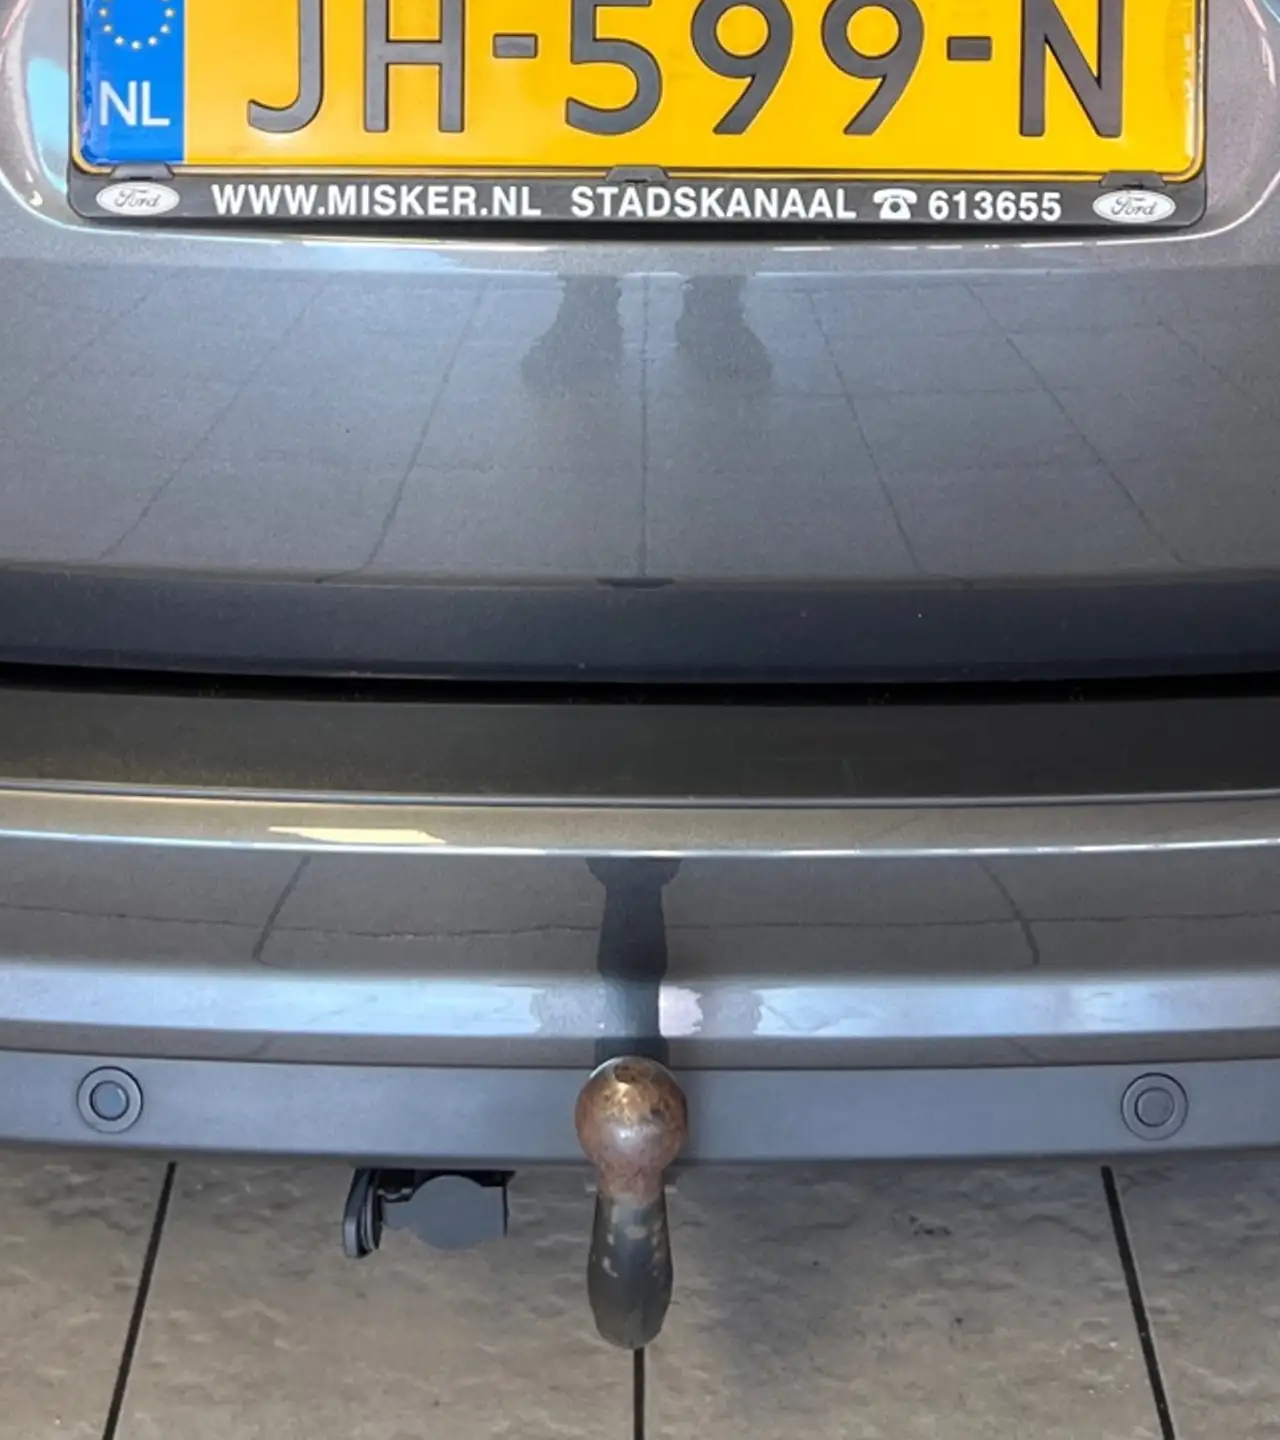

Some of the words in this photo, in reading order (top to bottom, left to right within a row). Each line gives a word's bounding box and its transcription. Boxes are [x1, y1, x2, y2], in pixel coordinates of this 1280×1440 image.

[100, 81, 169, 126] NL
[114, 188, 162, 208] Ford
[211, 184, 541, 216] WWW.MISKER.NL
[571, 187, 856, 219] STADSKANAAL
[928, 190, 1062, 221] 613655
[1110, 196, 1158, 216] Ford
